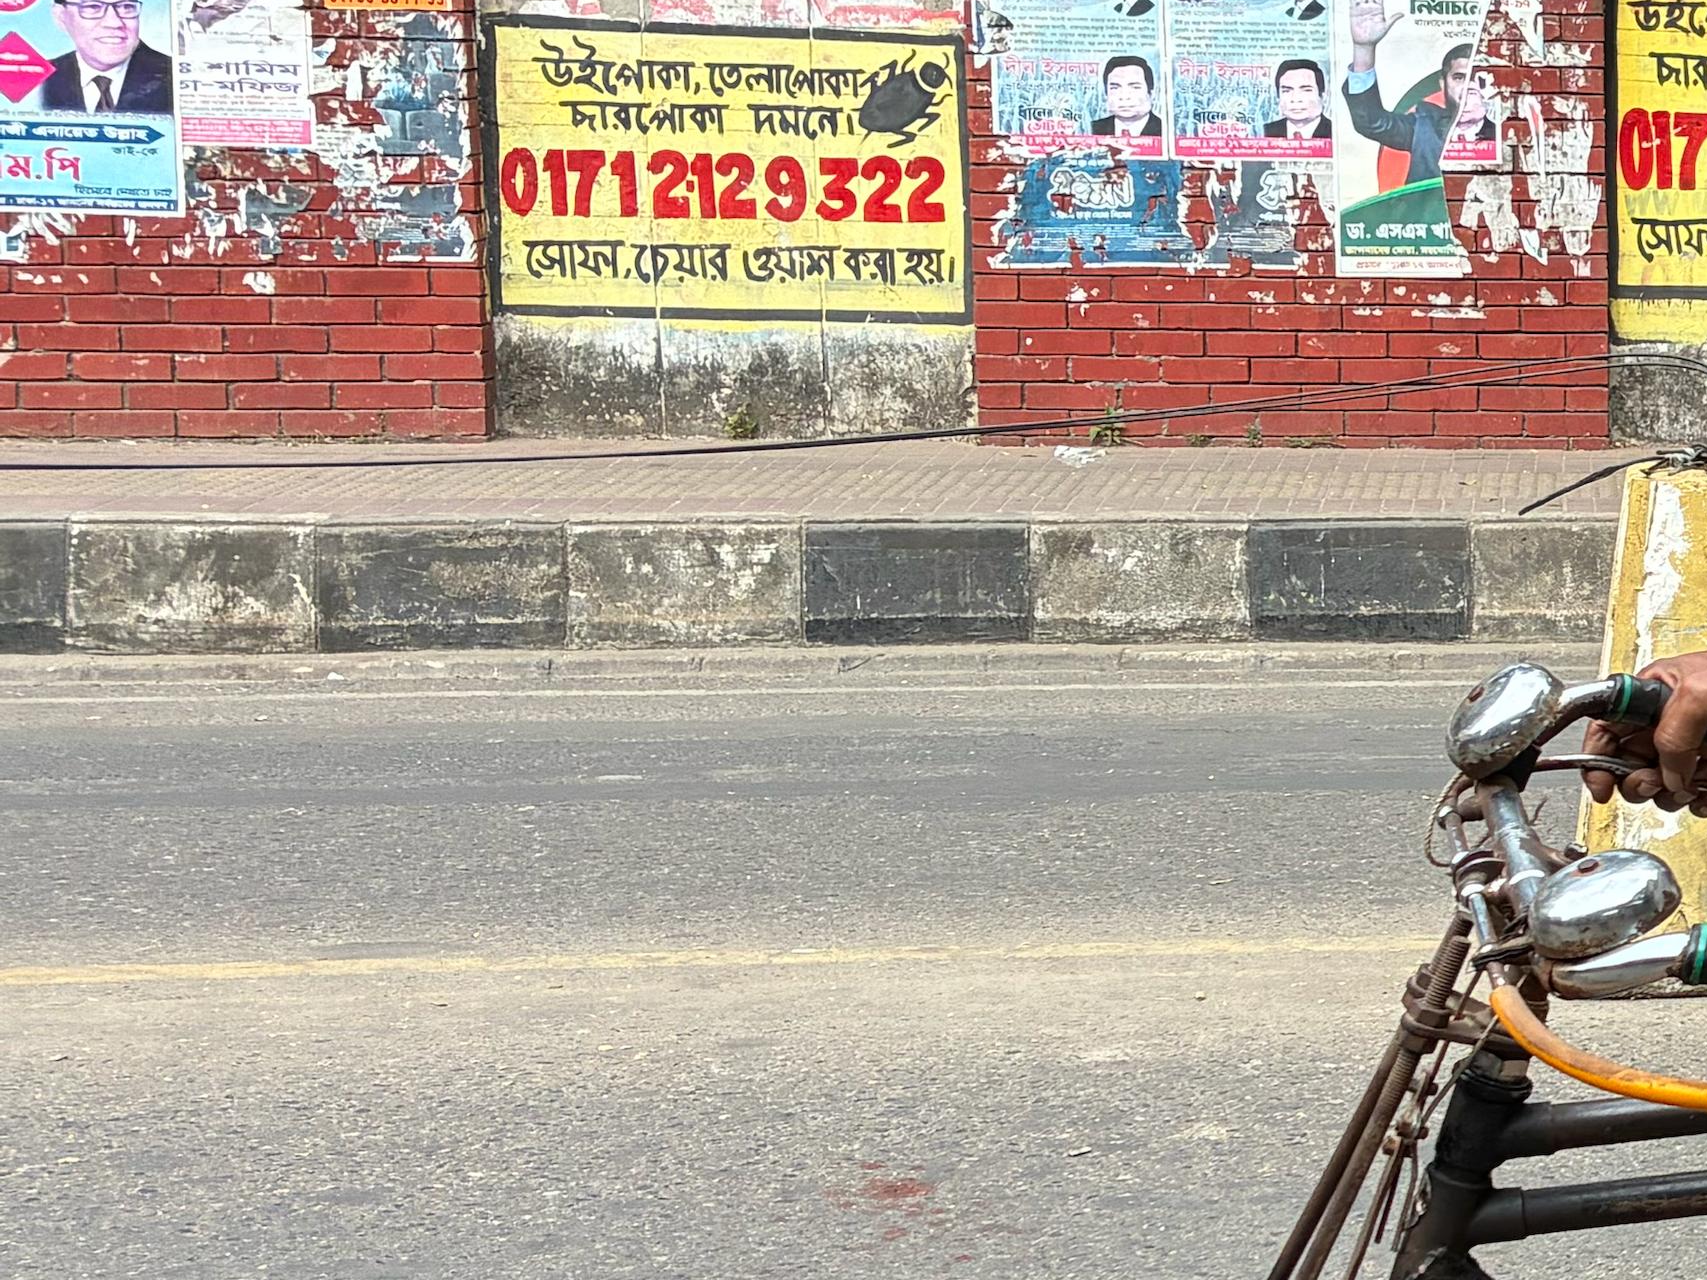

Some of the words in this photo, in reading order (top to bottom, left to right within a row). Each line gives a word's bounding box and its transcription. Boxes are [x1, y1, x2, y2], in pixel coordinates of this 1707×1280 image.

[0, 147, 81, 182] ম.পি
[1345, 222, 1372, 240] ডা.
[1375, 223, 1428, 239] এসএম
[1430, 222, 1450, 240] খা
